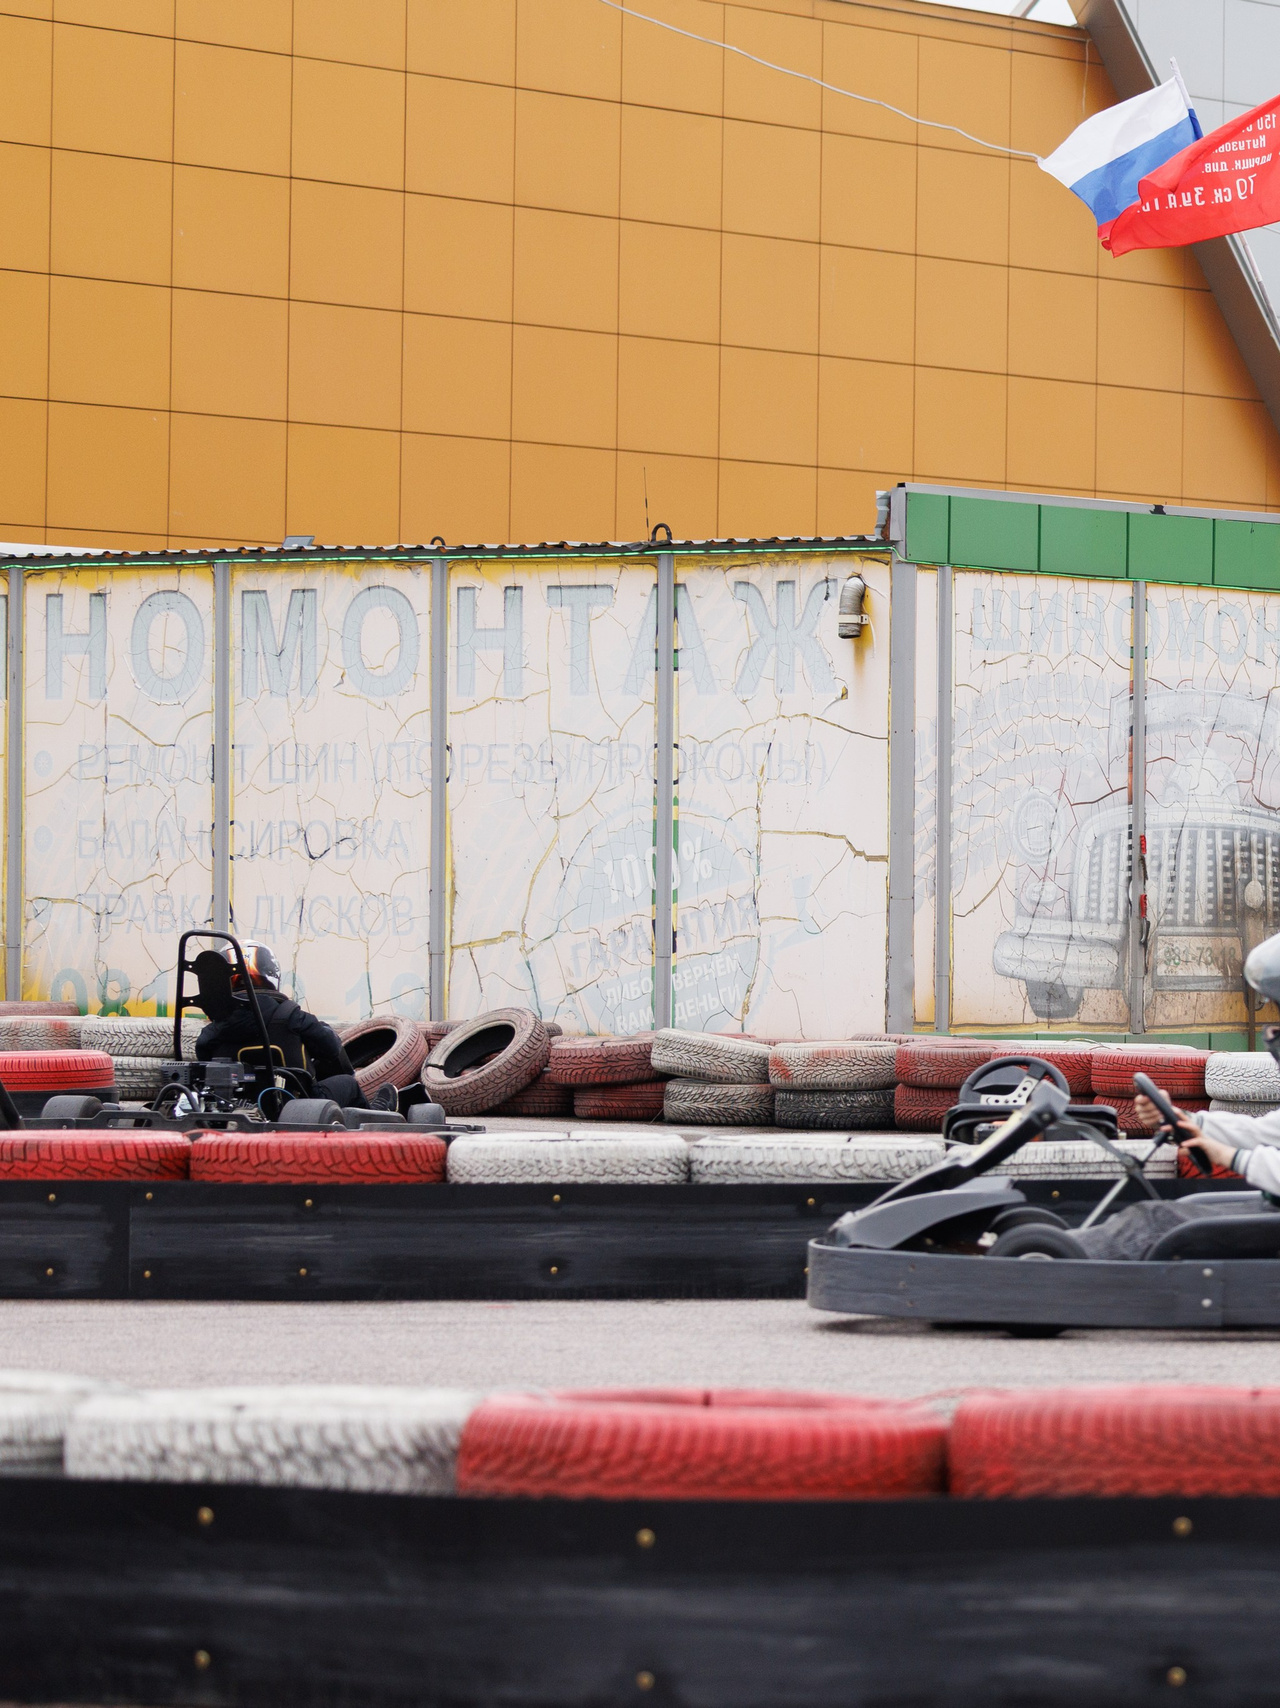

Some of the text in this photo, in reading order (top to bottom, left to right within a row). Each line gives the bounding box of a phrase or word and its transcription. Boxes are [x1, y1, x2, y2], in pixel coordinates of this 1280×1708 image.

[0, 580, 840, 703] НОМОНТАЖ
[78, 742, 255, 785] РЕМОНТ
[267, 743, 358, 784] ШИН
[77, 819, 411, 862] БАЛАНСИРОВКА
[603, 837, 713, 904] 100%
[251, 895, 416, 941] ДИСКОВ
